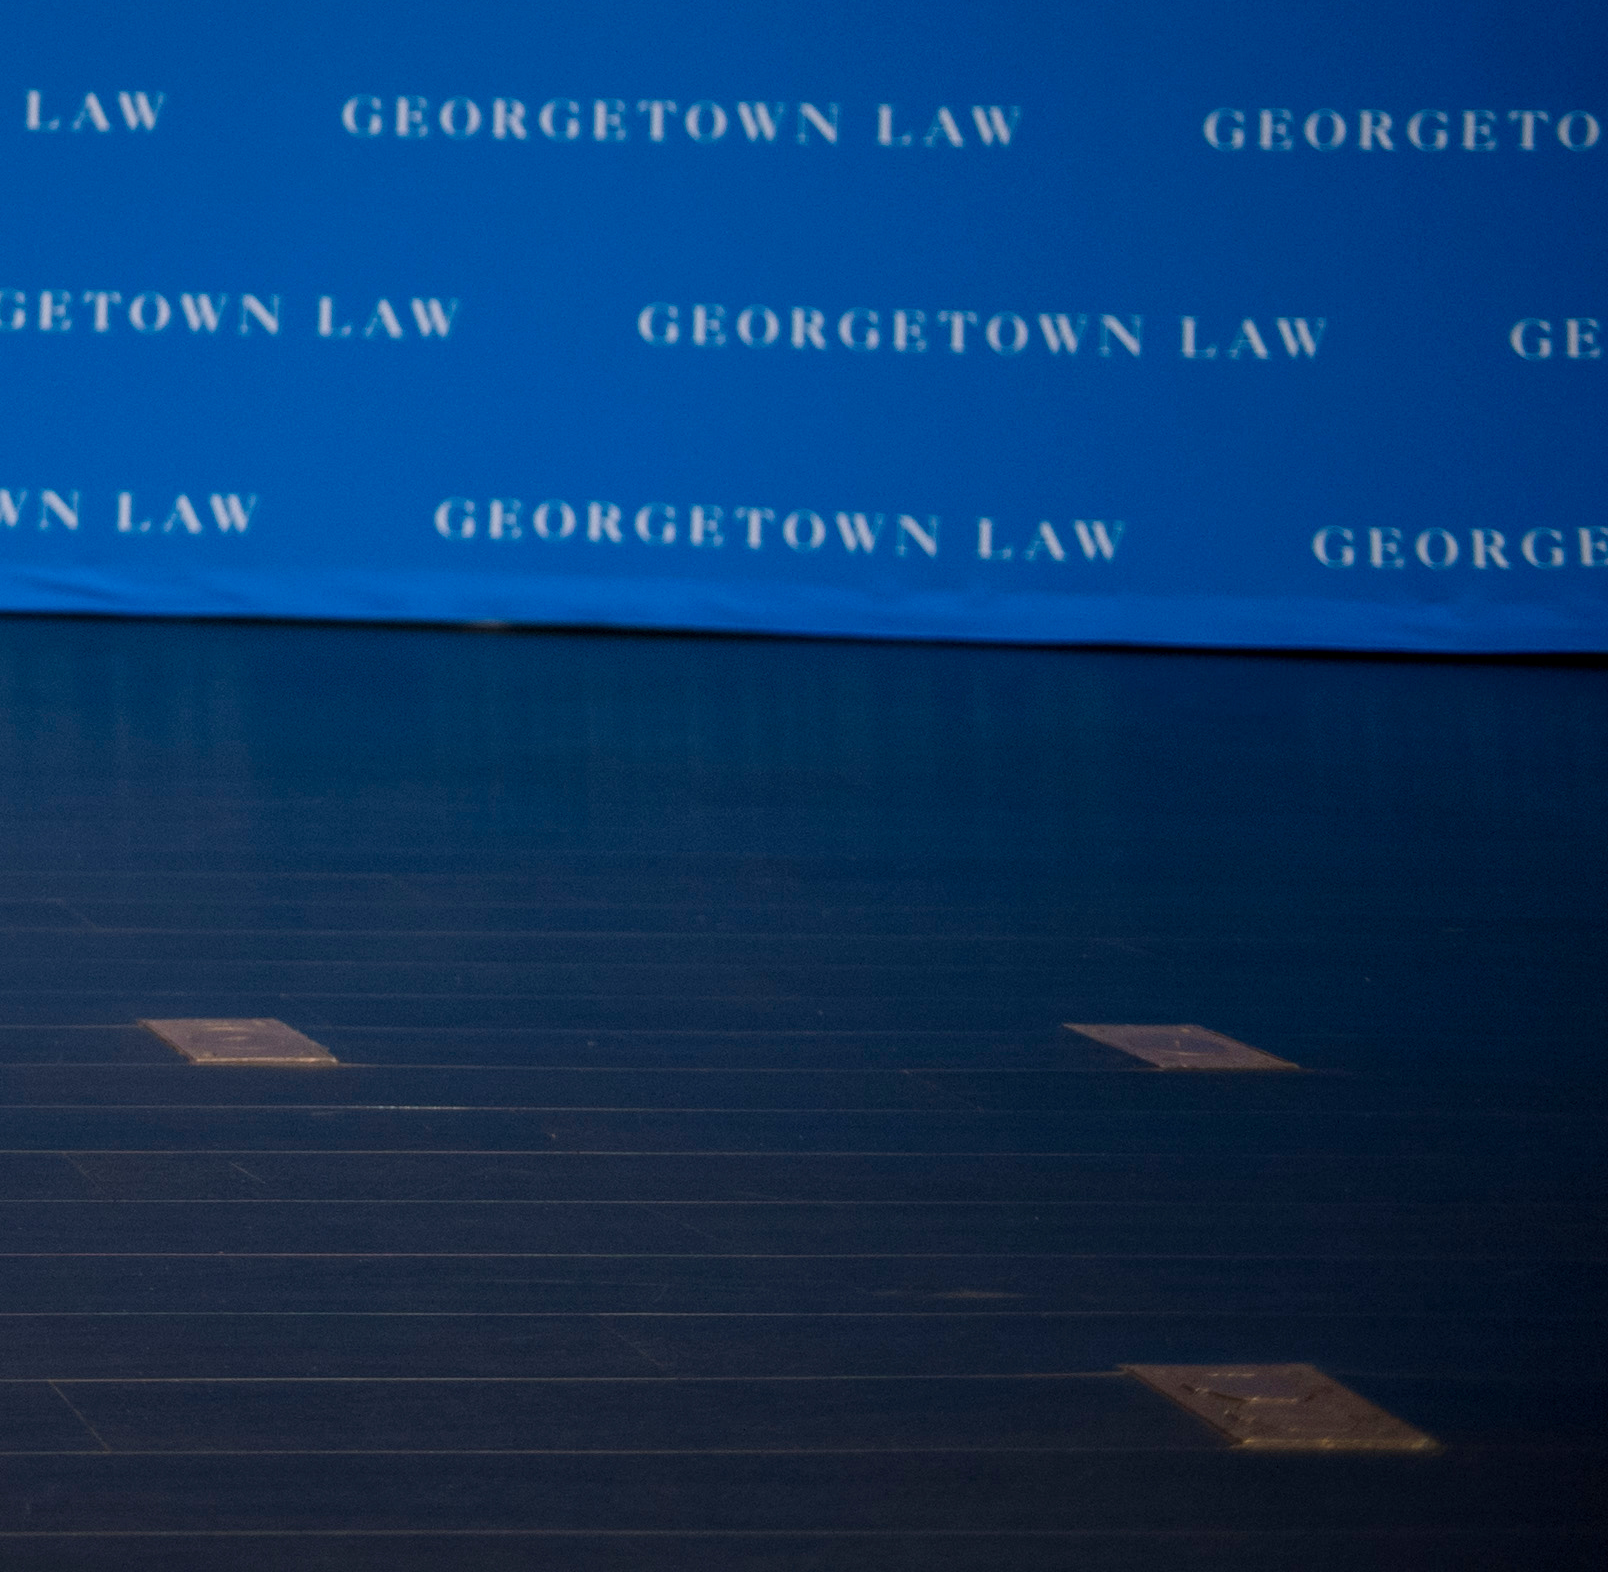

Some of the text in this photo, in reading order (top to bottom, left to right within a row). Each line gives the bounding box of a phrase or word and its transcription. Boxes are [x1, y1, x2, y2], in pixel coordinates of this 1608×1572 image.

[26, 90, 171, 132] LAW
[341, 96, 1019, 147] GEORGETOWN LAW
[318, 296, 458, 339] LAW
[637, 304, 1325, 359] GEORGETOWN LAW
[117, 492, 263, 534] LAW
[434, 499, 1123, 561] GEORGETOWN LAW
